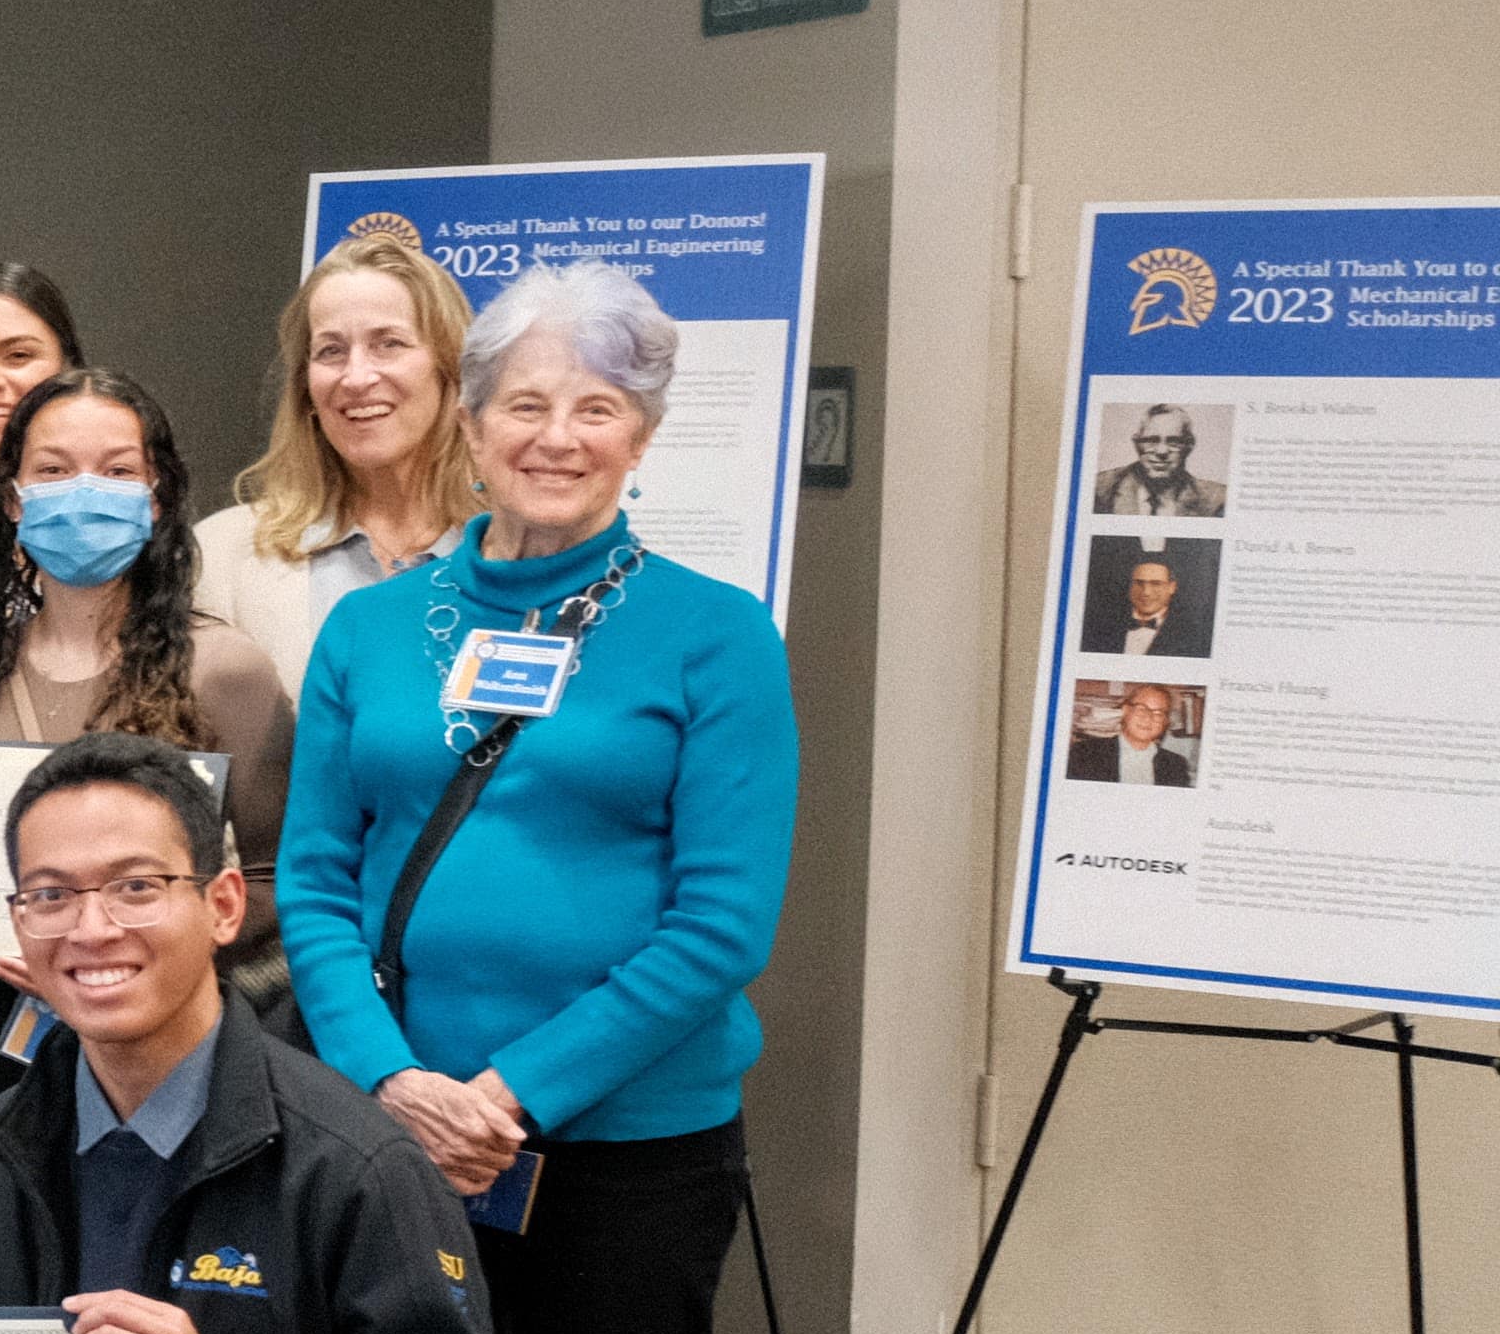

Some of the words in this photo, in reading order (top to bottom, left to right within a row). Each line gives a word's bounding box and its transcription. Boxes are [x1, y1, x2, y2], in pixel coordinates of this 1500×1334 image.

[435, 223, 449, 238] A
[453, 220, 518, 239] Special
[523, 217, 581, 234] Thank
[585, 216, 621, 233] You
[626, 217, 646, 231] to
[651, 217, 686, 231] our
[690, 212, 767, 230] Donors!
[433, 243, 522, 278] 2023
[532, 238, 641, 258] Mechanical
[645, 237, 765, 258] Engineering
[1232, 262, 1249, 278] A
[1254, 261, 1331, 281] Special
[1336, 260, 1407, 278] Thank
[1413, 261, 1457, 278] You
[1464, 261, 1488, 278] to
[1227, 287, 1335, 324] 2023
[1350, 286, 1479, 304] Mechanical
[1346, 309, 1496, 331] Scholarships
[1218, 678, 1274, 694] Francis
[1278, 681, 1330, 700] Huang
[1206, 817, 1276, 835] Autodesk
[1079, 854, 1188, 876] AUTODESK
[189, 1254, 263, 1288] Baja
